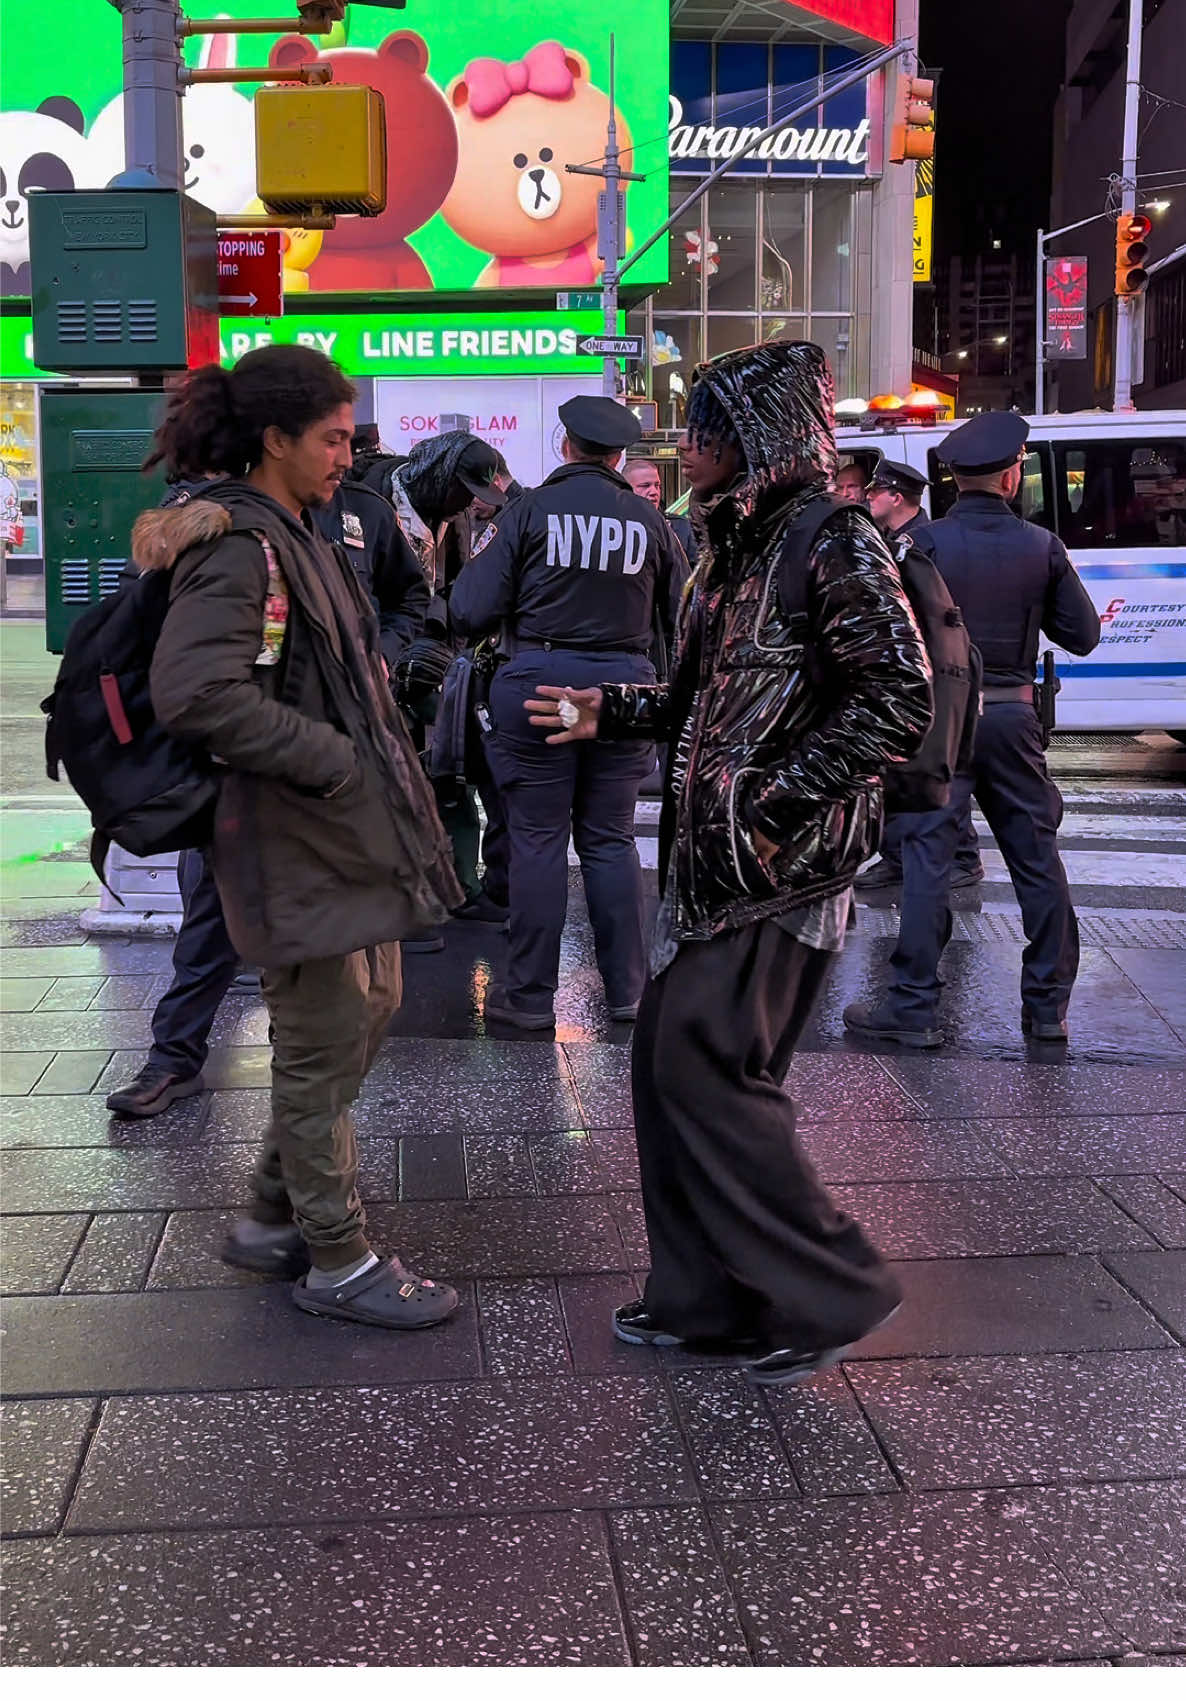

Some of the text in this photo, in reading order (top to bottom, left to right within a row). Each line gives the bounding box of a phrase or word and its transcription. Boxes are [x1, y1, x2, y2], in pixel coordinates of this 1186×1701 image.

[217, 240, 265, 256] TOPPING
[217, 260, 239, 276] ime
[363, 331, 434, 357] LINE
[442, 328, 576, 357] FRIENDS
[586, 341, 634, 351] ONE WAY
[546, 514, 648, 575] NYPD
[1106, 599, 1186, 613] COURTESY
[1100, 614, 1186, 628] PROFESSION
[1100, 635, 1152, 644] ESPECT
[670, 715, 695, 795] MILANO
